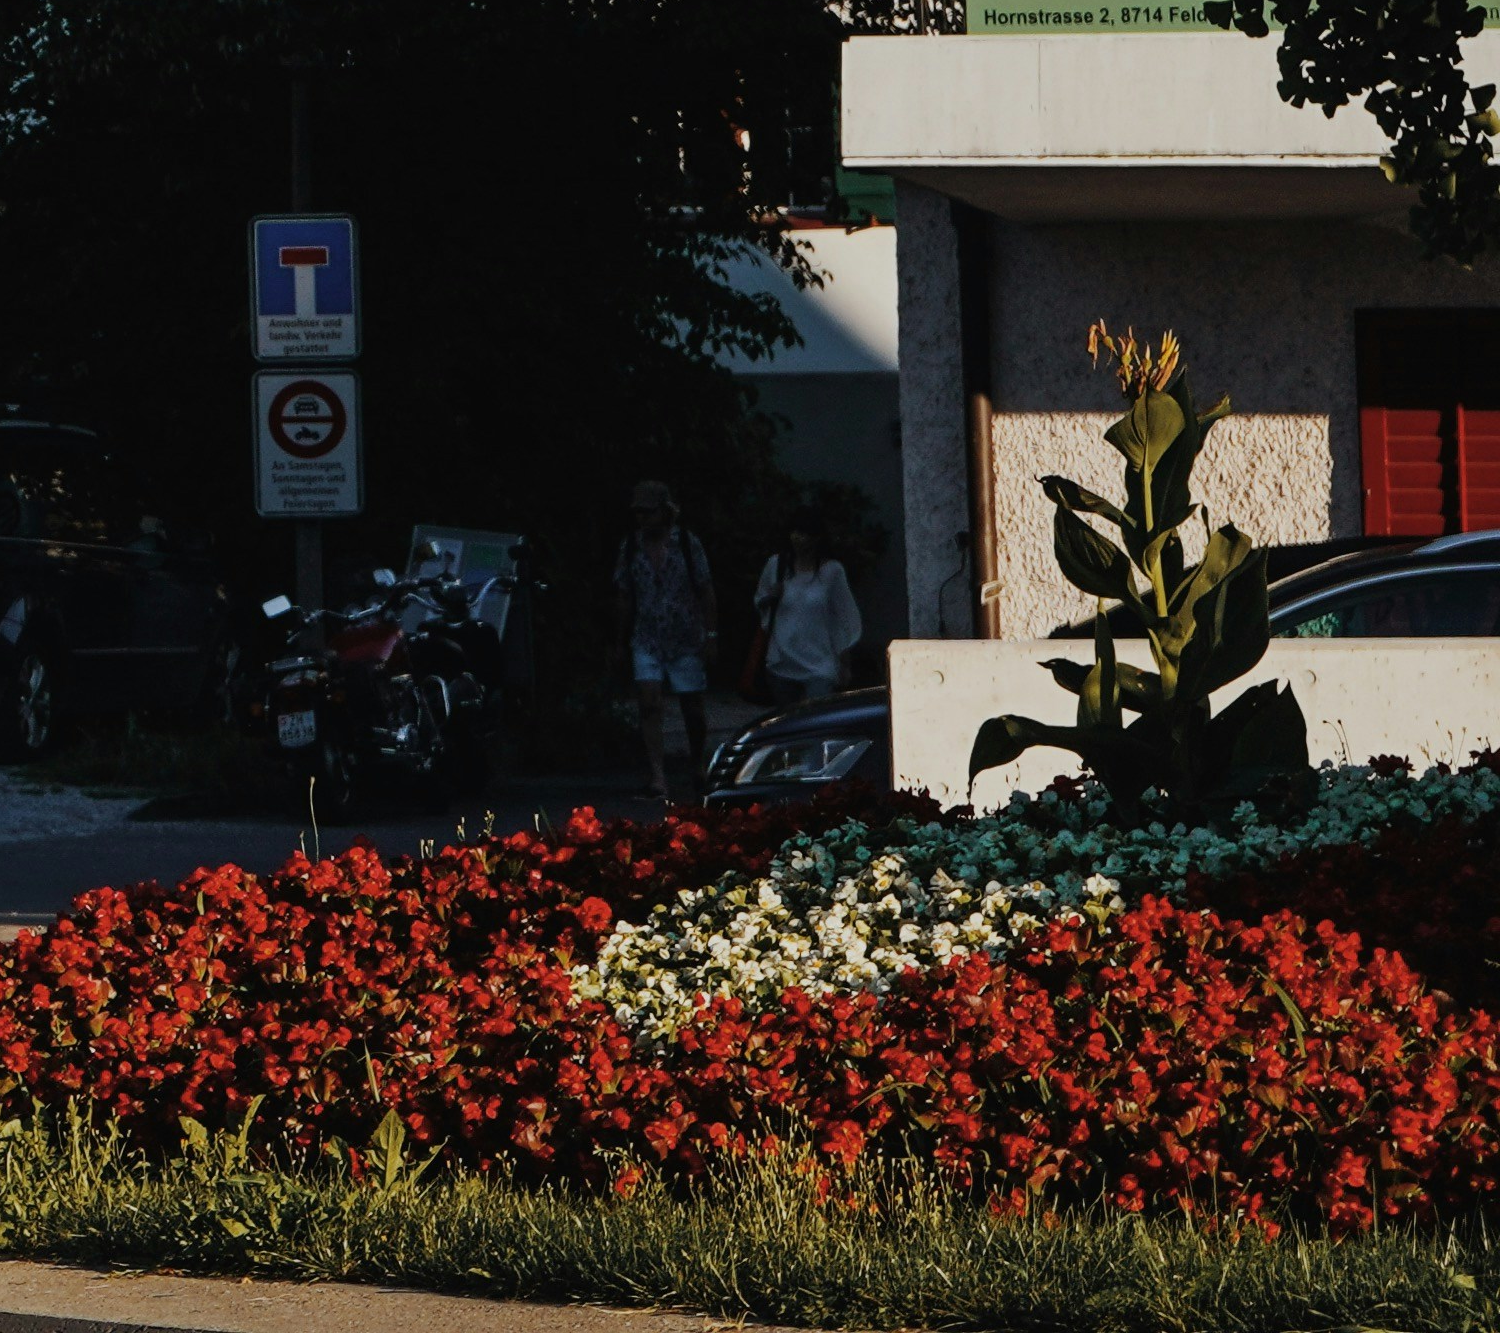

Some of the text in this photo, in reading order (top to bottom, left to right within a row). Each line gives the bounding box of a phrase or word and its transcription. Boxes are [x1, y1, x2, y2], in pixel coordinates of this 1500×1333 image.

[984, 8, 1094, 25] Hornstrasse
[1099, 8, 1115, 26] 2,
[1121, 6, 1163, 23] 8714
